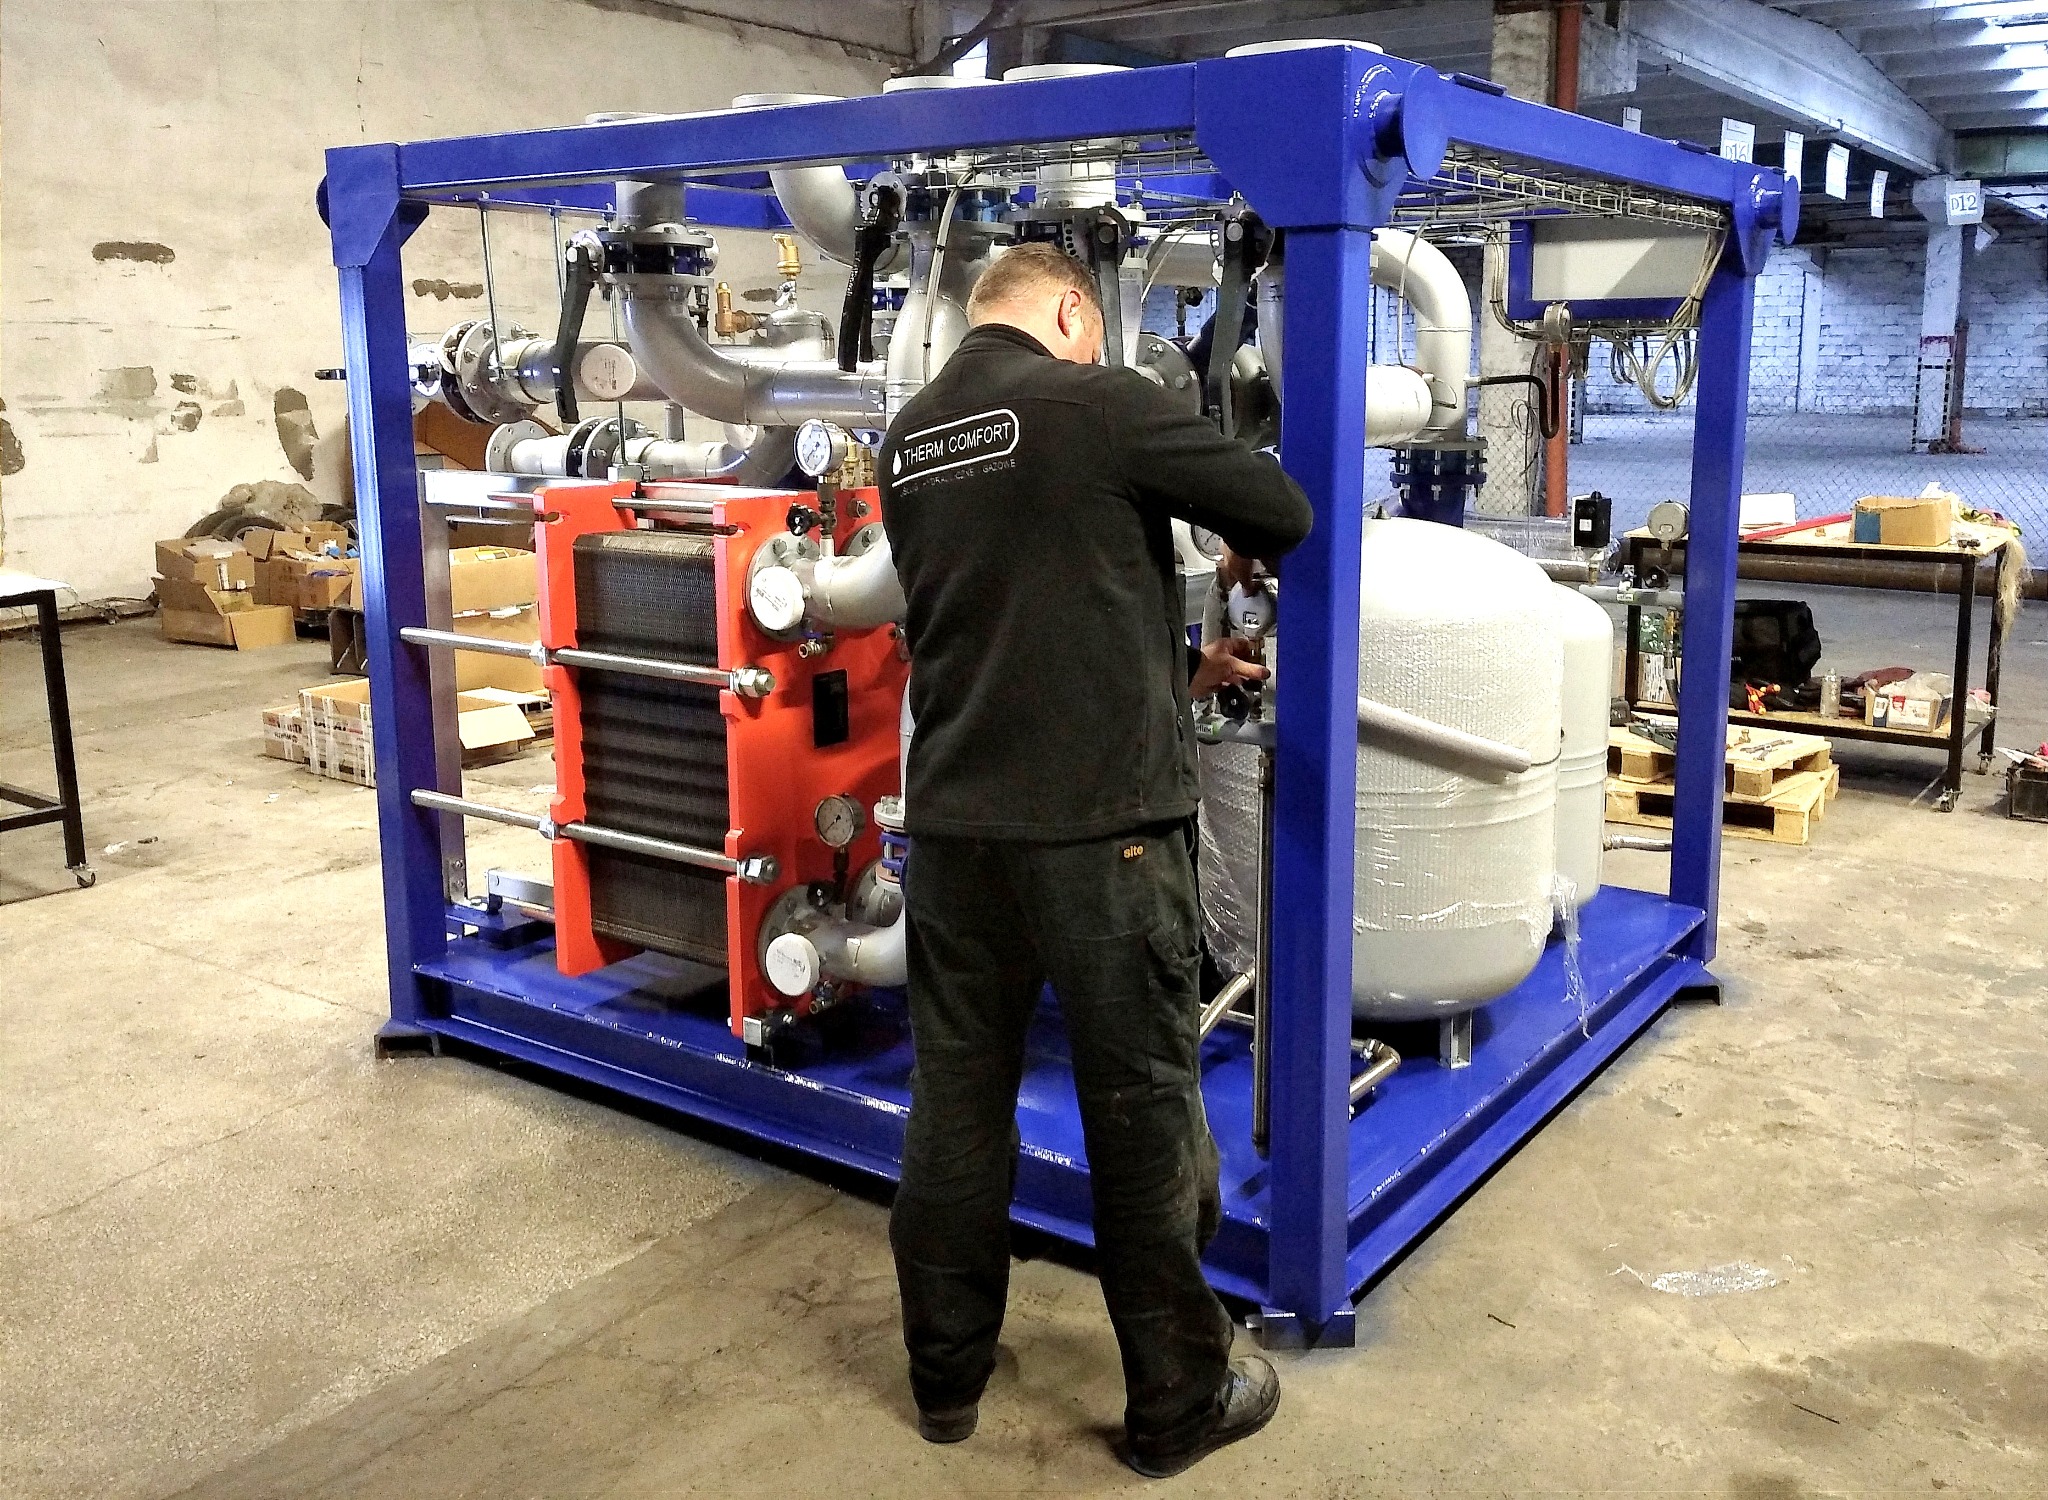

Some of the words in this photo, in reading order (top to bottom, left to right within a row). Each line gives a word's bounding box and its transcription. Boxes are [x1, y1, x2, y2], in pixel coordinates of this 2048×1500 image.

[1950, 194, 1978, 211] D12
[903, 439, 944, 467] THERM
[948, 422, 1012, 453] COMFORT
